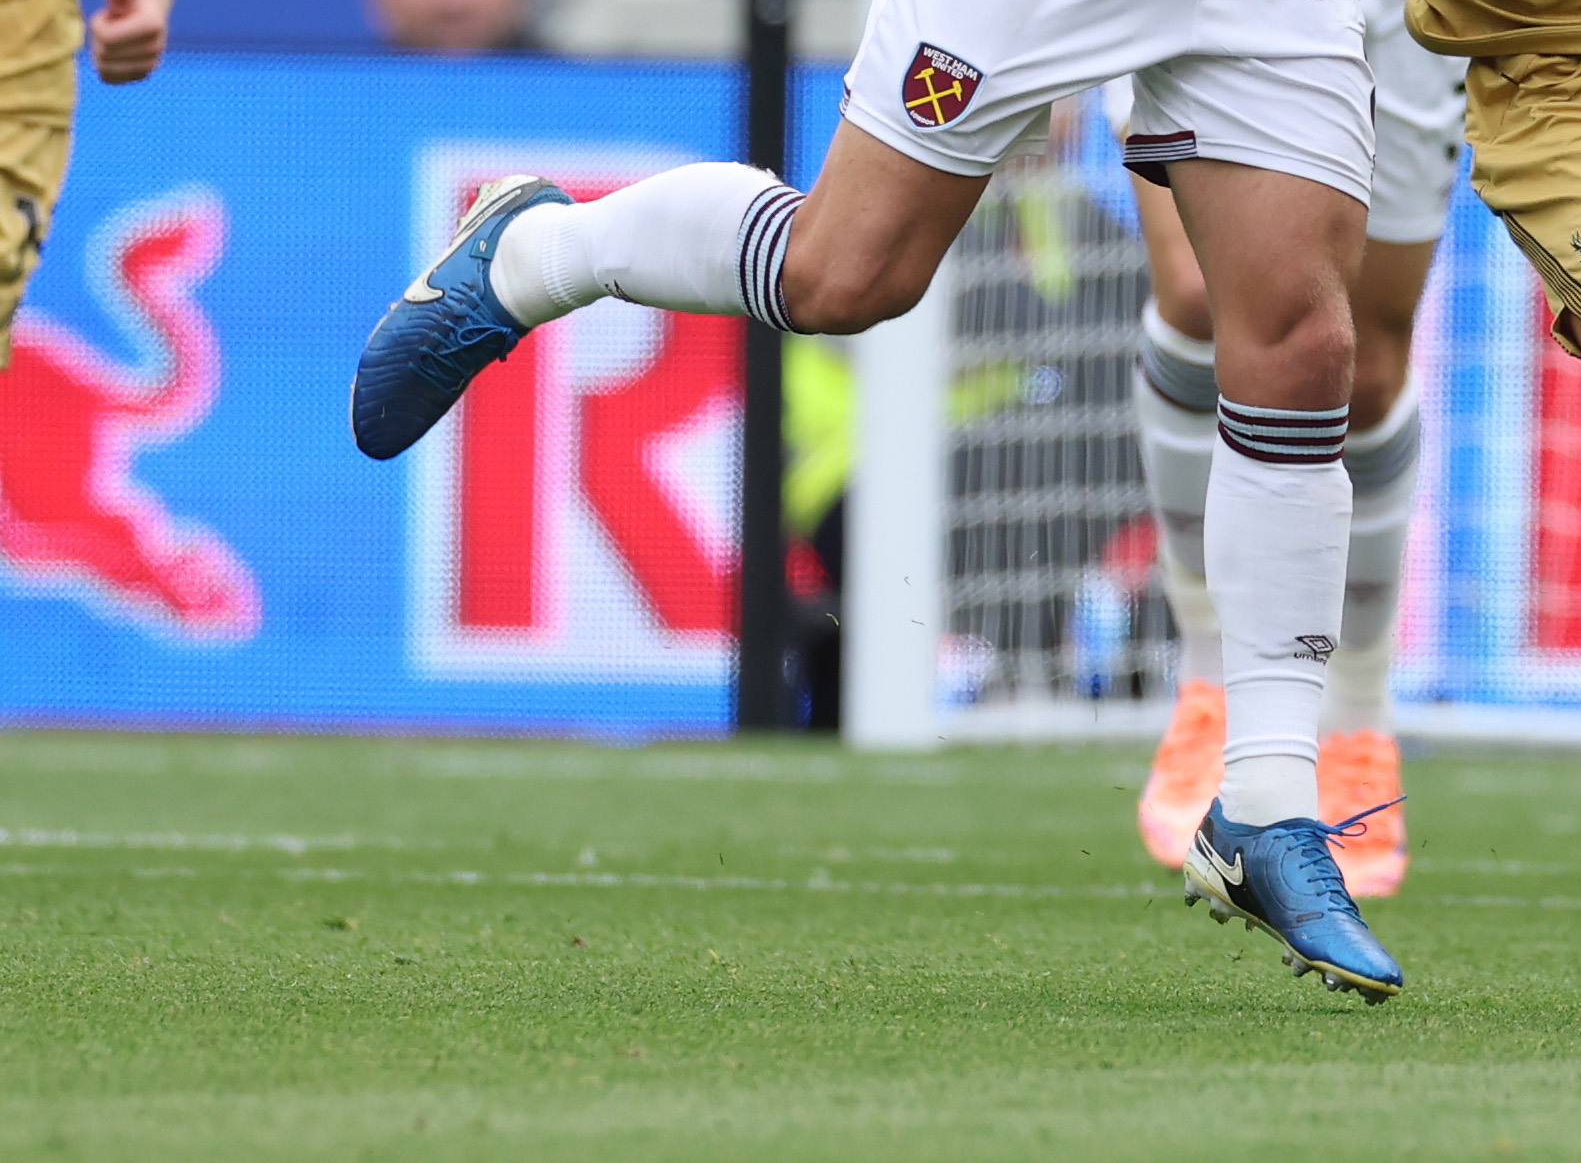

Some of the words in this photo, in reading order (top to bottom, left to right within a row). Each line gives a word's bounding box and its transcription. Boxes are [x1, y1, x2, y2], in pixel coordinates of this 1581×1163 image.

[922, 46, 954, 66] WEST
[951, 58, 979, 82] HAM
[930, 58, 965, 81] UNITED
